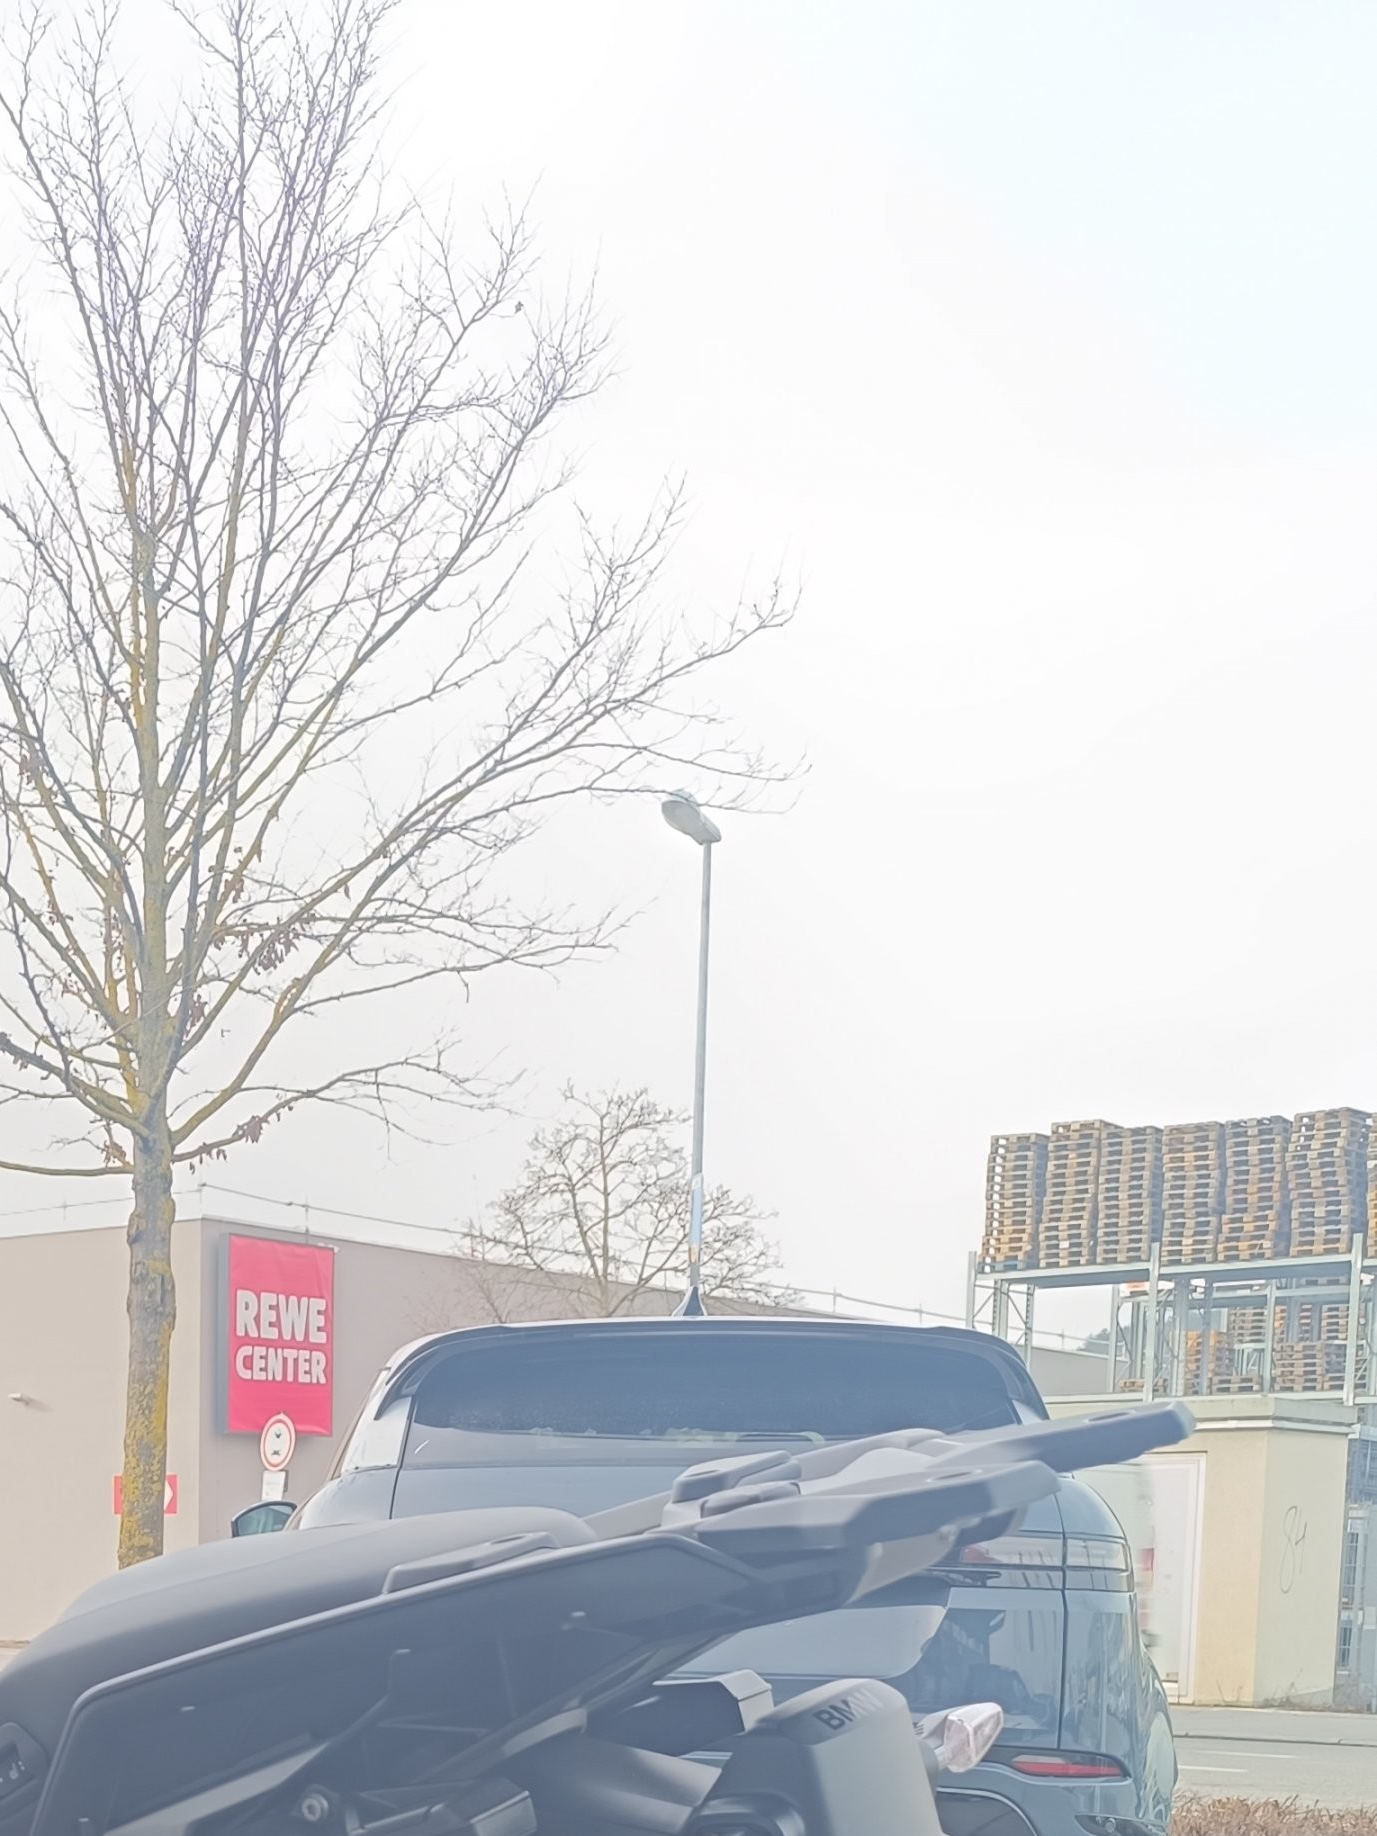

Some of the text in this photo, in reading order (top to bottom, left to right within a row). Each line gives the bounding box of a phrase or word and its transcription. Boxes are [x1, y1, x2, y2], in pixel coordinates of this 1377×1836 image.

[236, 1288, 327, 1344] REWE
[235, 1345, 327, 1385] CENTER
[811, 1687, 885, 1730] BMW
